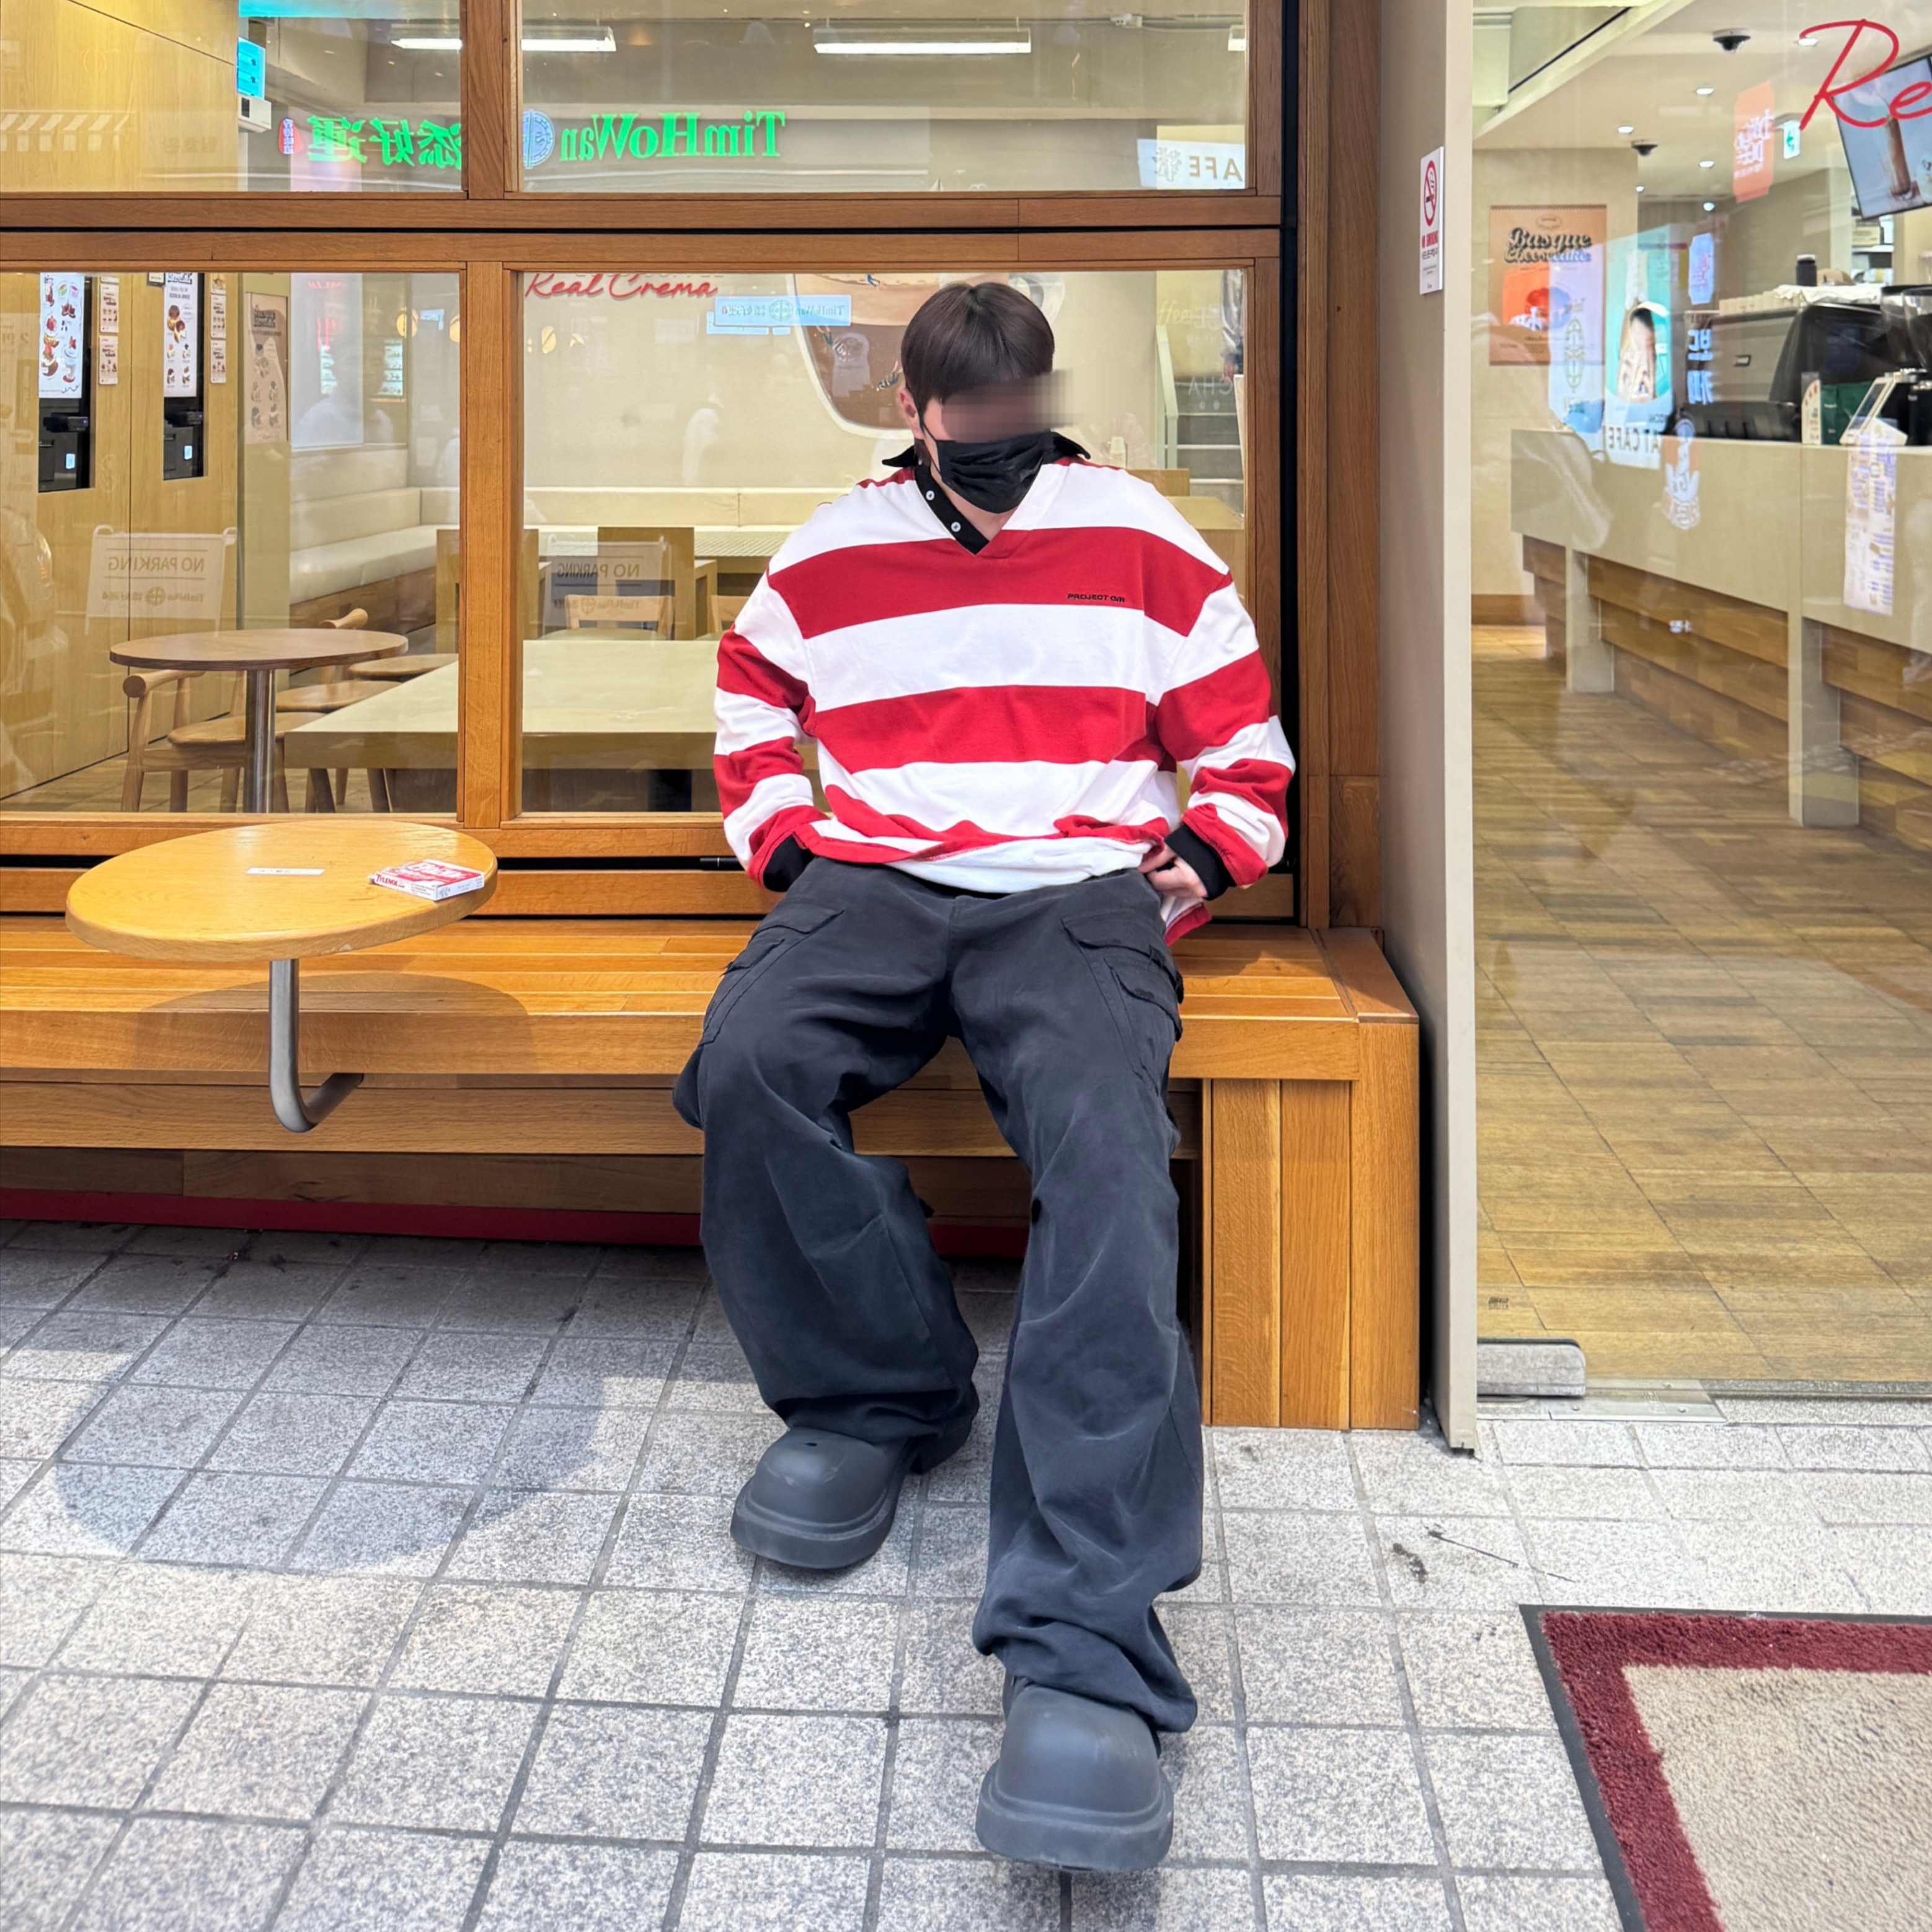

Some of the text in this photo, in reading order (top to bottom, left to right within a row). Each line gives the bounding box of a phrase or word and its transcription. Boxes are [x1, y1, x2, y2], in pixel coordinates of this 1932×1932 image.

[1799, 19, 1932, 131] Re
[1507, 227, 1592, 252] Basque
[525, 273, 719, 299] Real Crema
[1066, 593, 1109, 601] PROJECT
[376, 873, 398, 887] TYLENOL
